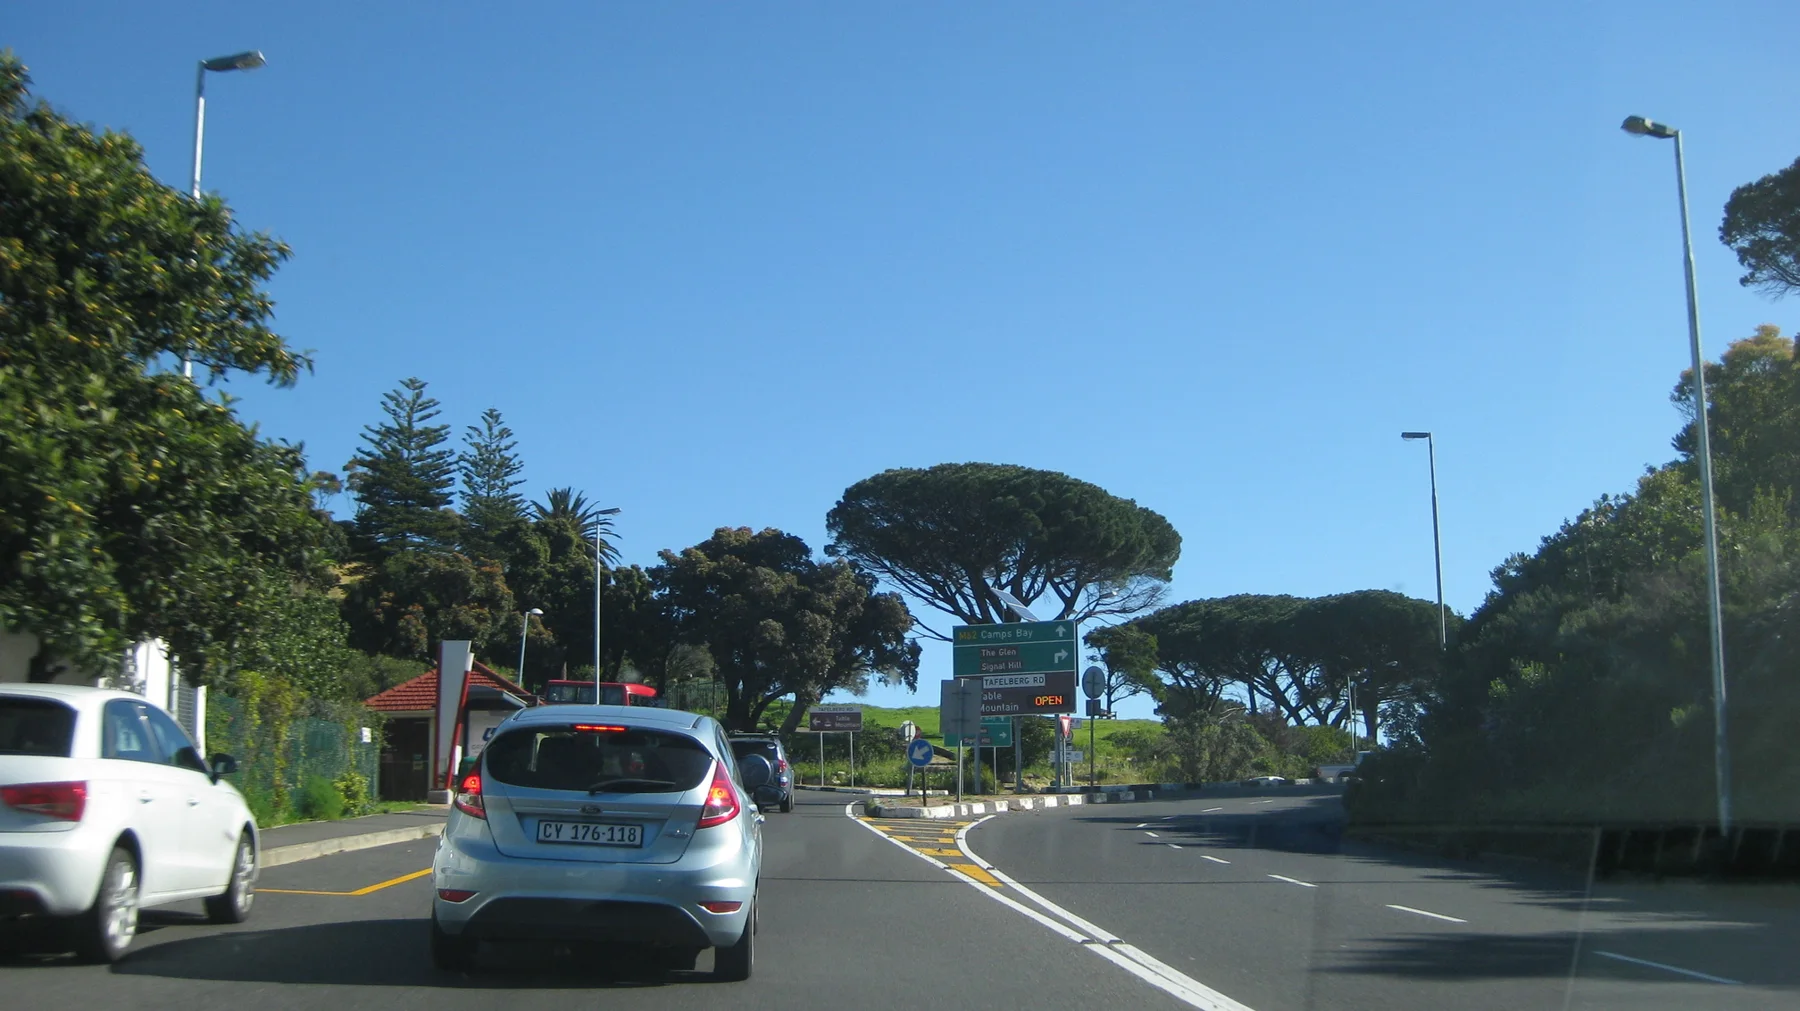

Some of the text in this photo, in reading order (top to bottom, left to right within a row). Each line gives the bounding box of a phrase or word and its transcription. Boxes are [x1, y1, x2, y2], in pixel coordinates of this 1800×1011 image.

[981, 630, 1012, 640] Camps
[1016, 629, 1033, 639] Bay
[981, 648, 1017, 657] The Glen
[981, 661, 1022, 672] Signal Hill
[984, 676, 1045, 686] TAFELBERG RD
[981, 691, 1002, 700] able
[1034, 695, 1063, 706] OPEN
[543, 822, 564, 839] CY
